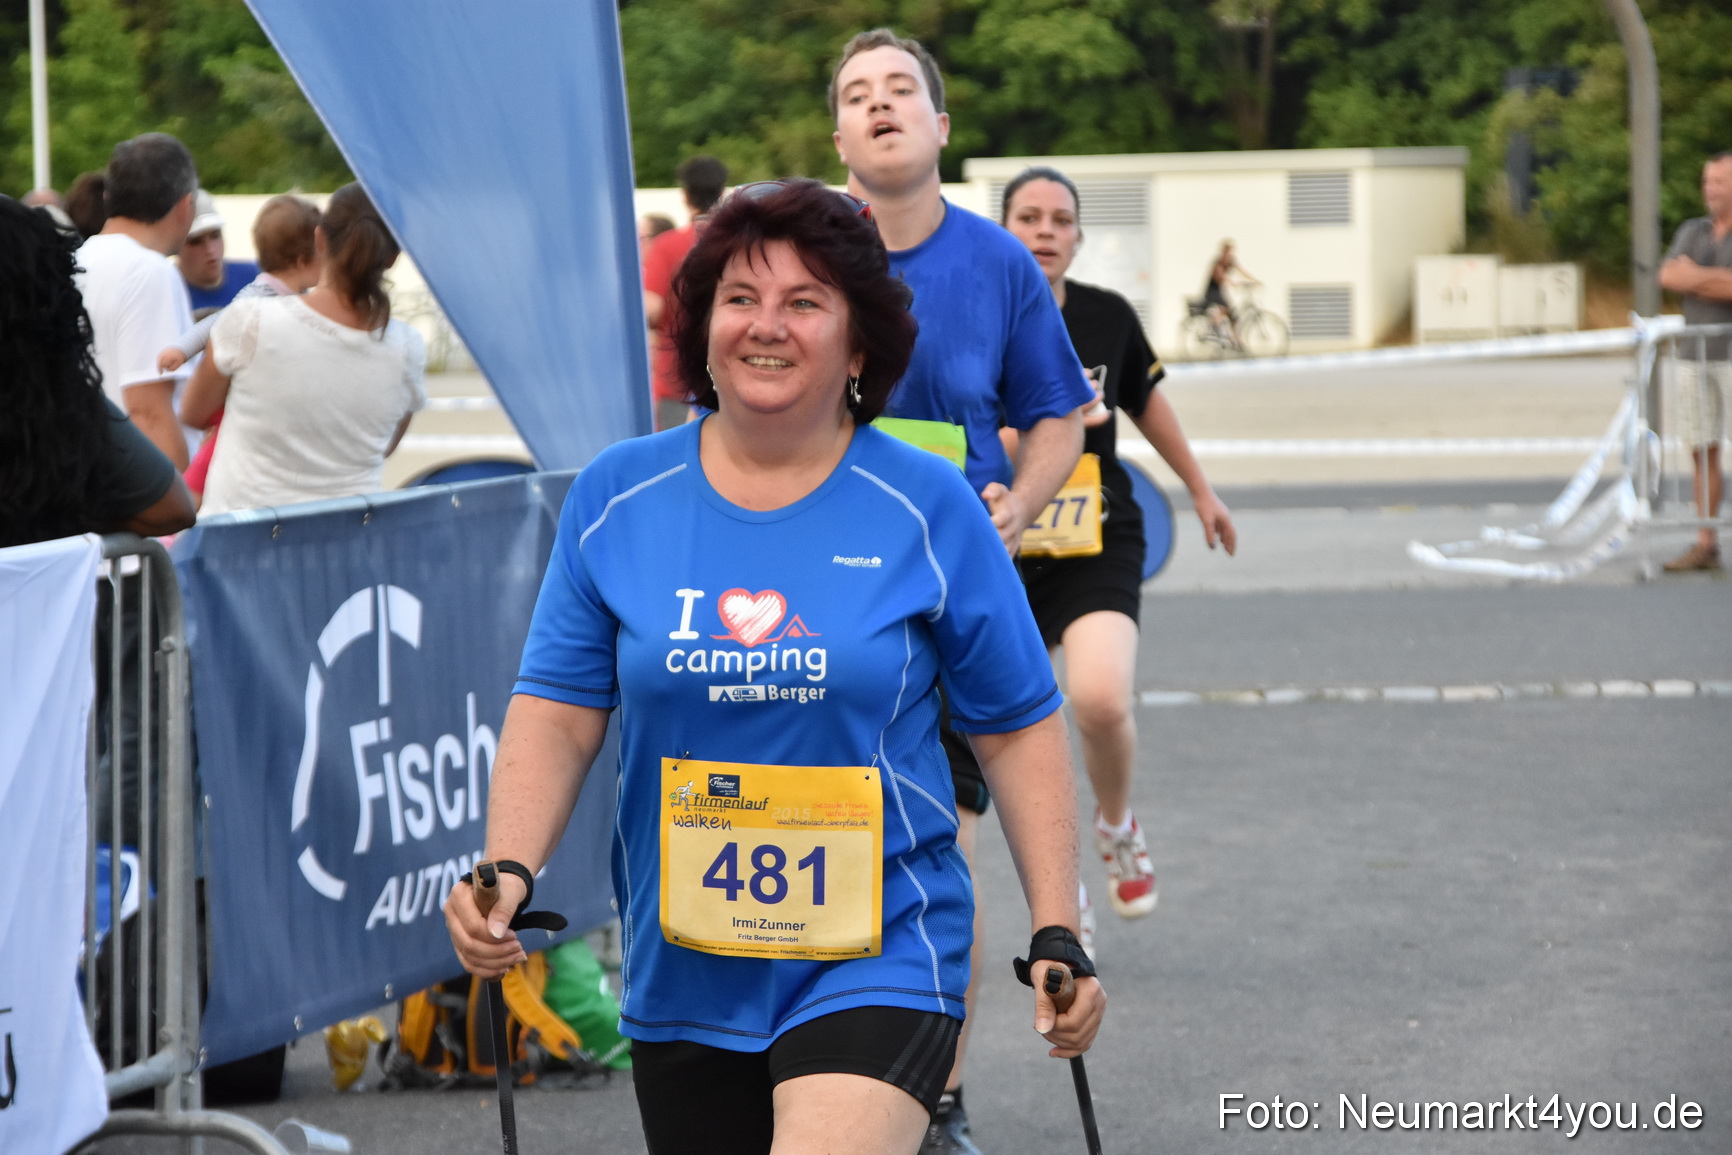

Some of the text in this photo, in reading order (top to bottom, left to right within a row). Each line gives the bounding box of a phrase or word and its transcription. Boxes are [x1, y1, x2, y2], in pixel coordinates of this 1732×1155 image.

[1026, 495, 1088, 529] 77
[832, 555, 870, 566] Regatta
[669, 588, 705, 640] I
[666, 643, 827, 683] camping
[768, 684, 826, 703] Berger
[349, 691, 500, 855] Fisch
[694, 793, 770, 811] firmenlauf
[673, 813, 732, 830] walken
[771, 806, 812, 820] 2015
[702, 842, 826, 906] 481
[365, 849, 486, 930] AUTO
[732, 917, 806, 931] Irmi Zunner
[737, 933, 752, 941] Fritz
[754, 935, 776, 943] Berger
